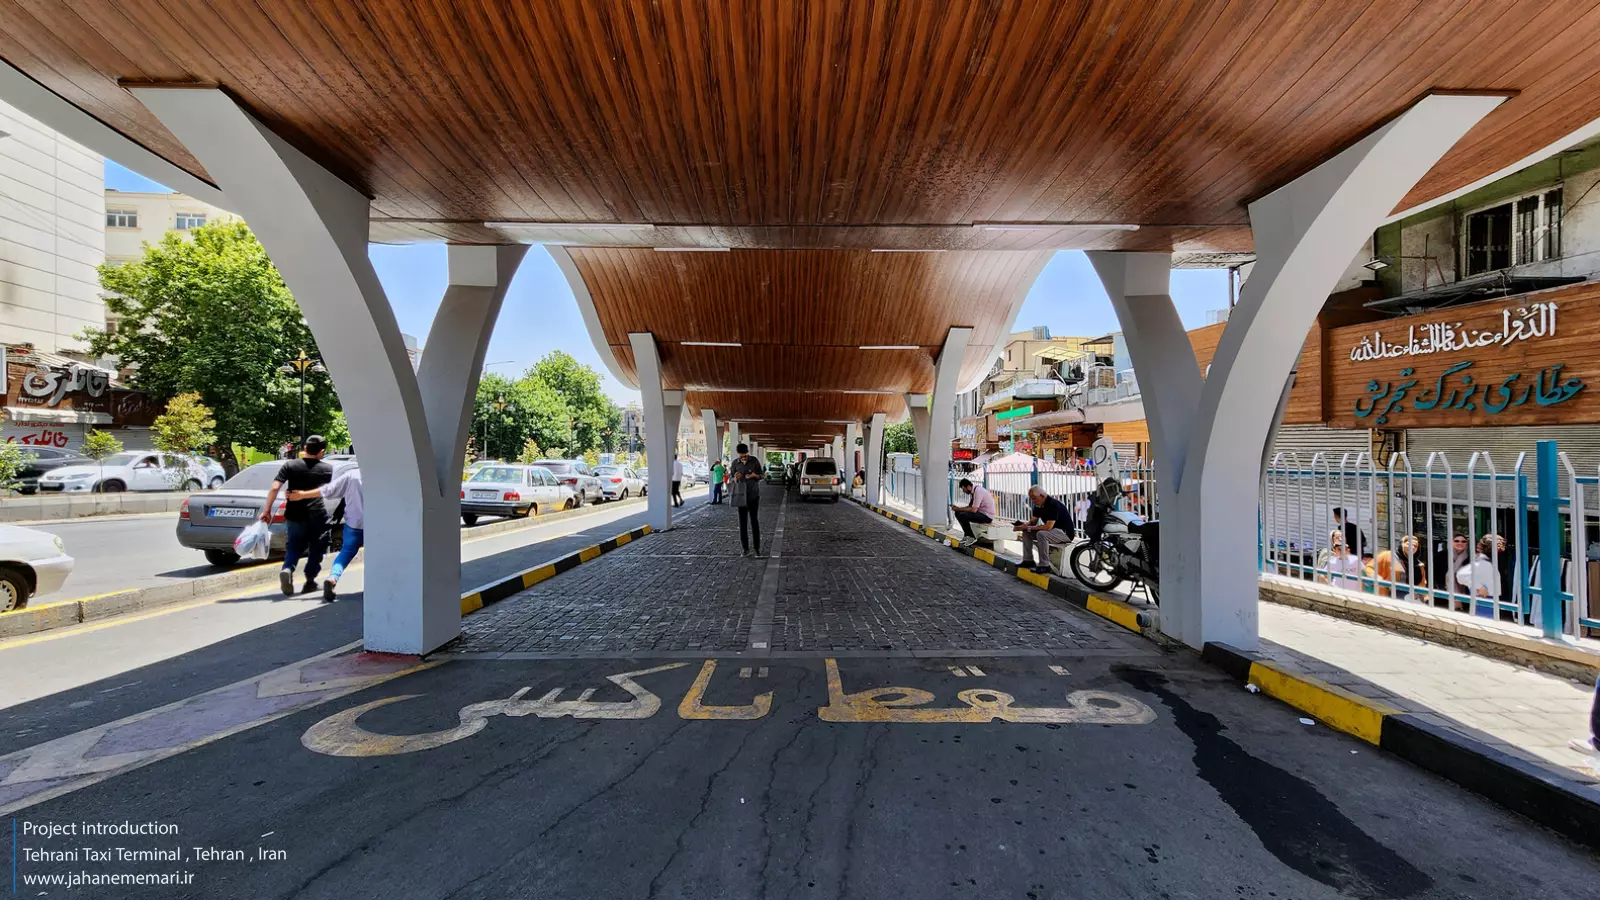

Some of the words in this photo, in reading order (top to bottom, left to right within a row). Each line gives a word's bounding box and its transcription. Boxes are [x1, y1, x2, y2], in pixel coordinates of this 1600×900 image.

[1354, 367, 1418, 425] تجریش
[1414, 361, 1476, 411] بزرگ
[300, 660, 774, 757] تاکسی
[817, 658, 1158, 724] فقط
